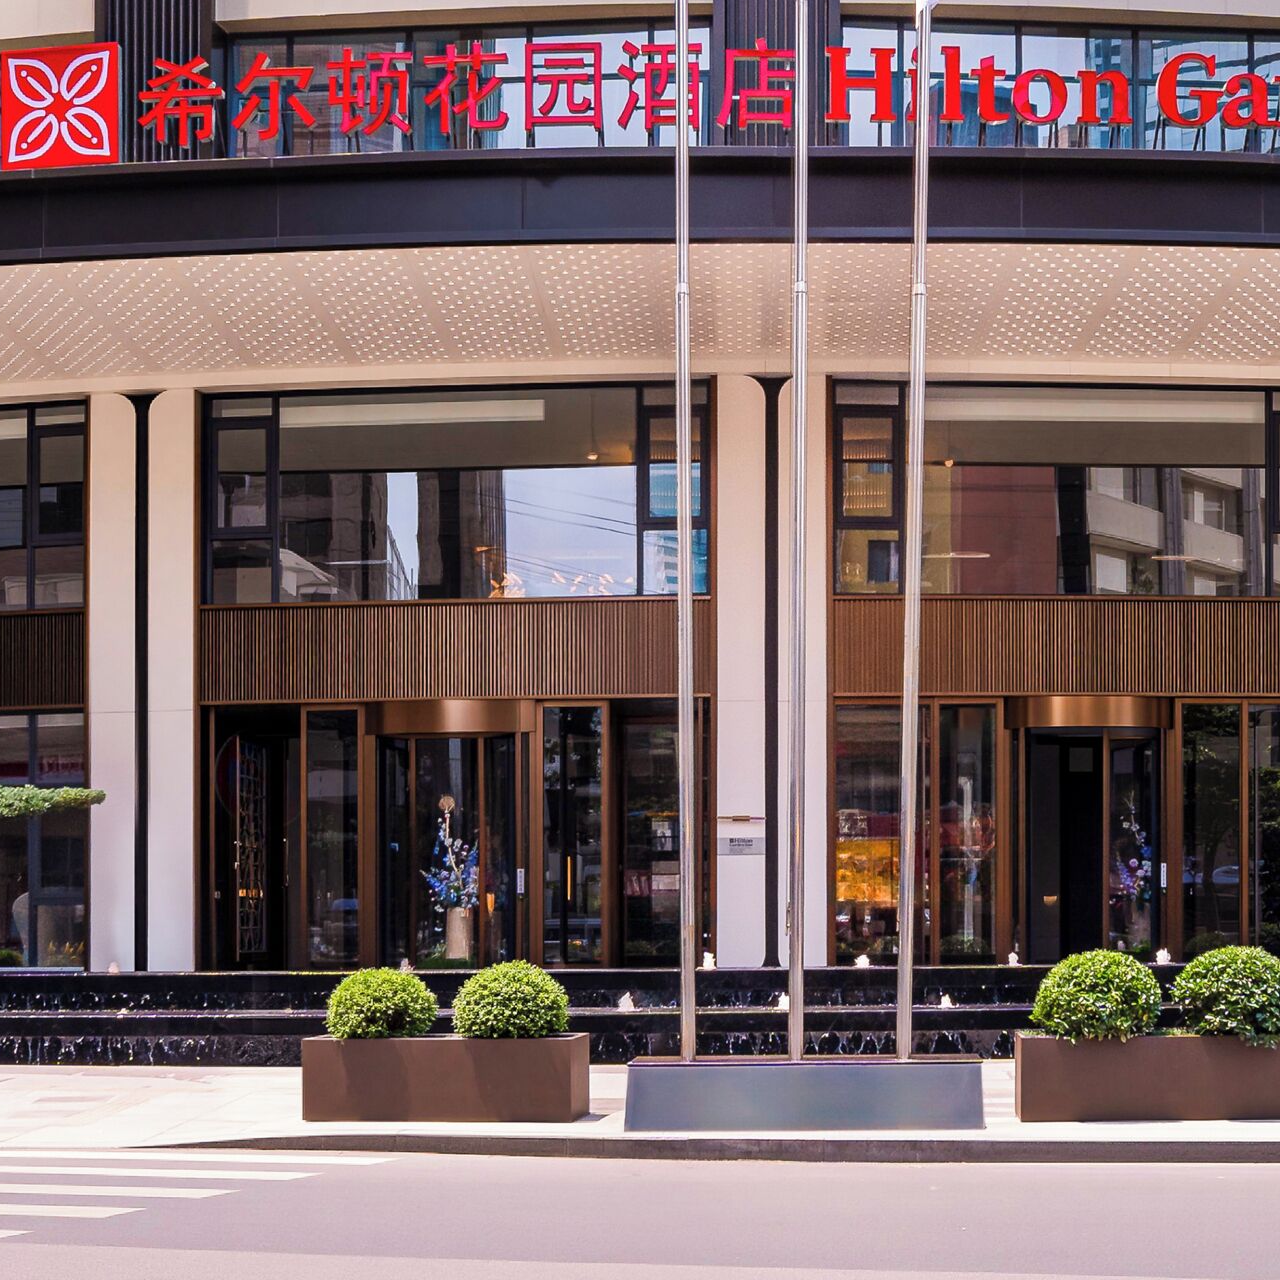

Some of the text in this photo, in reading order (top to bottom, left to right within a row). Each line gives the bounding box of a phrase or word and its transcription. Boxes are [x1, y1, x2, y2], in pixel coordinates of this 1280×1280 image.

[138, 38, 796, 148] 希尔顿花园酒店
